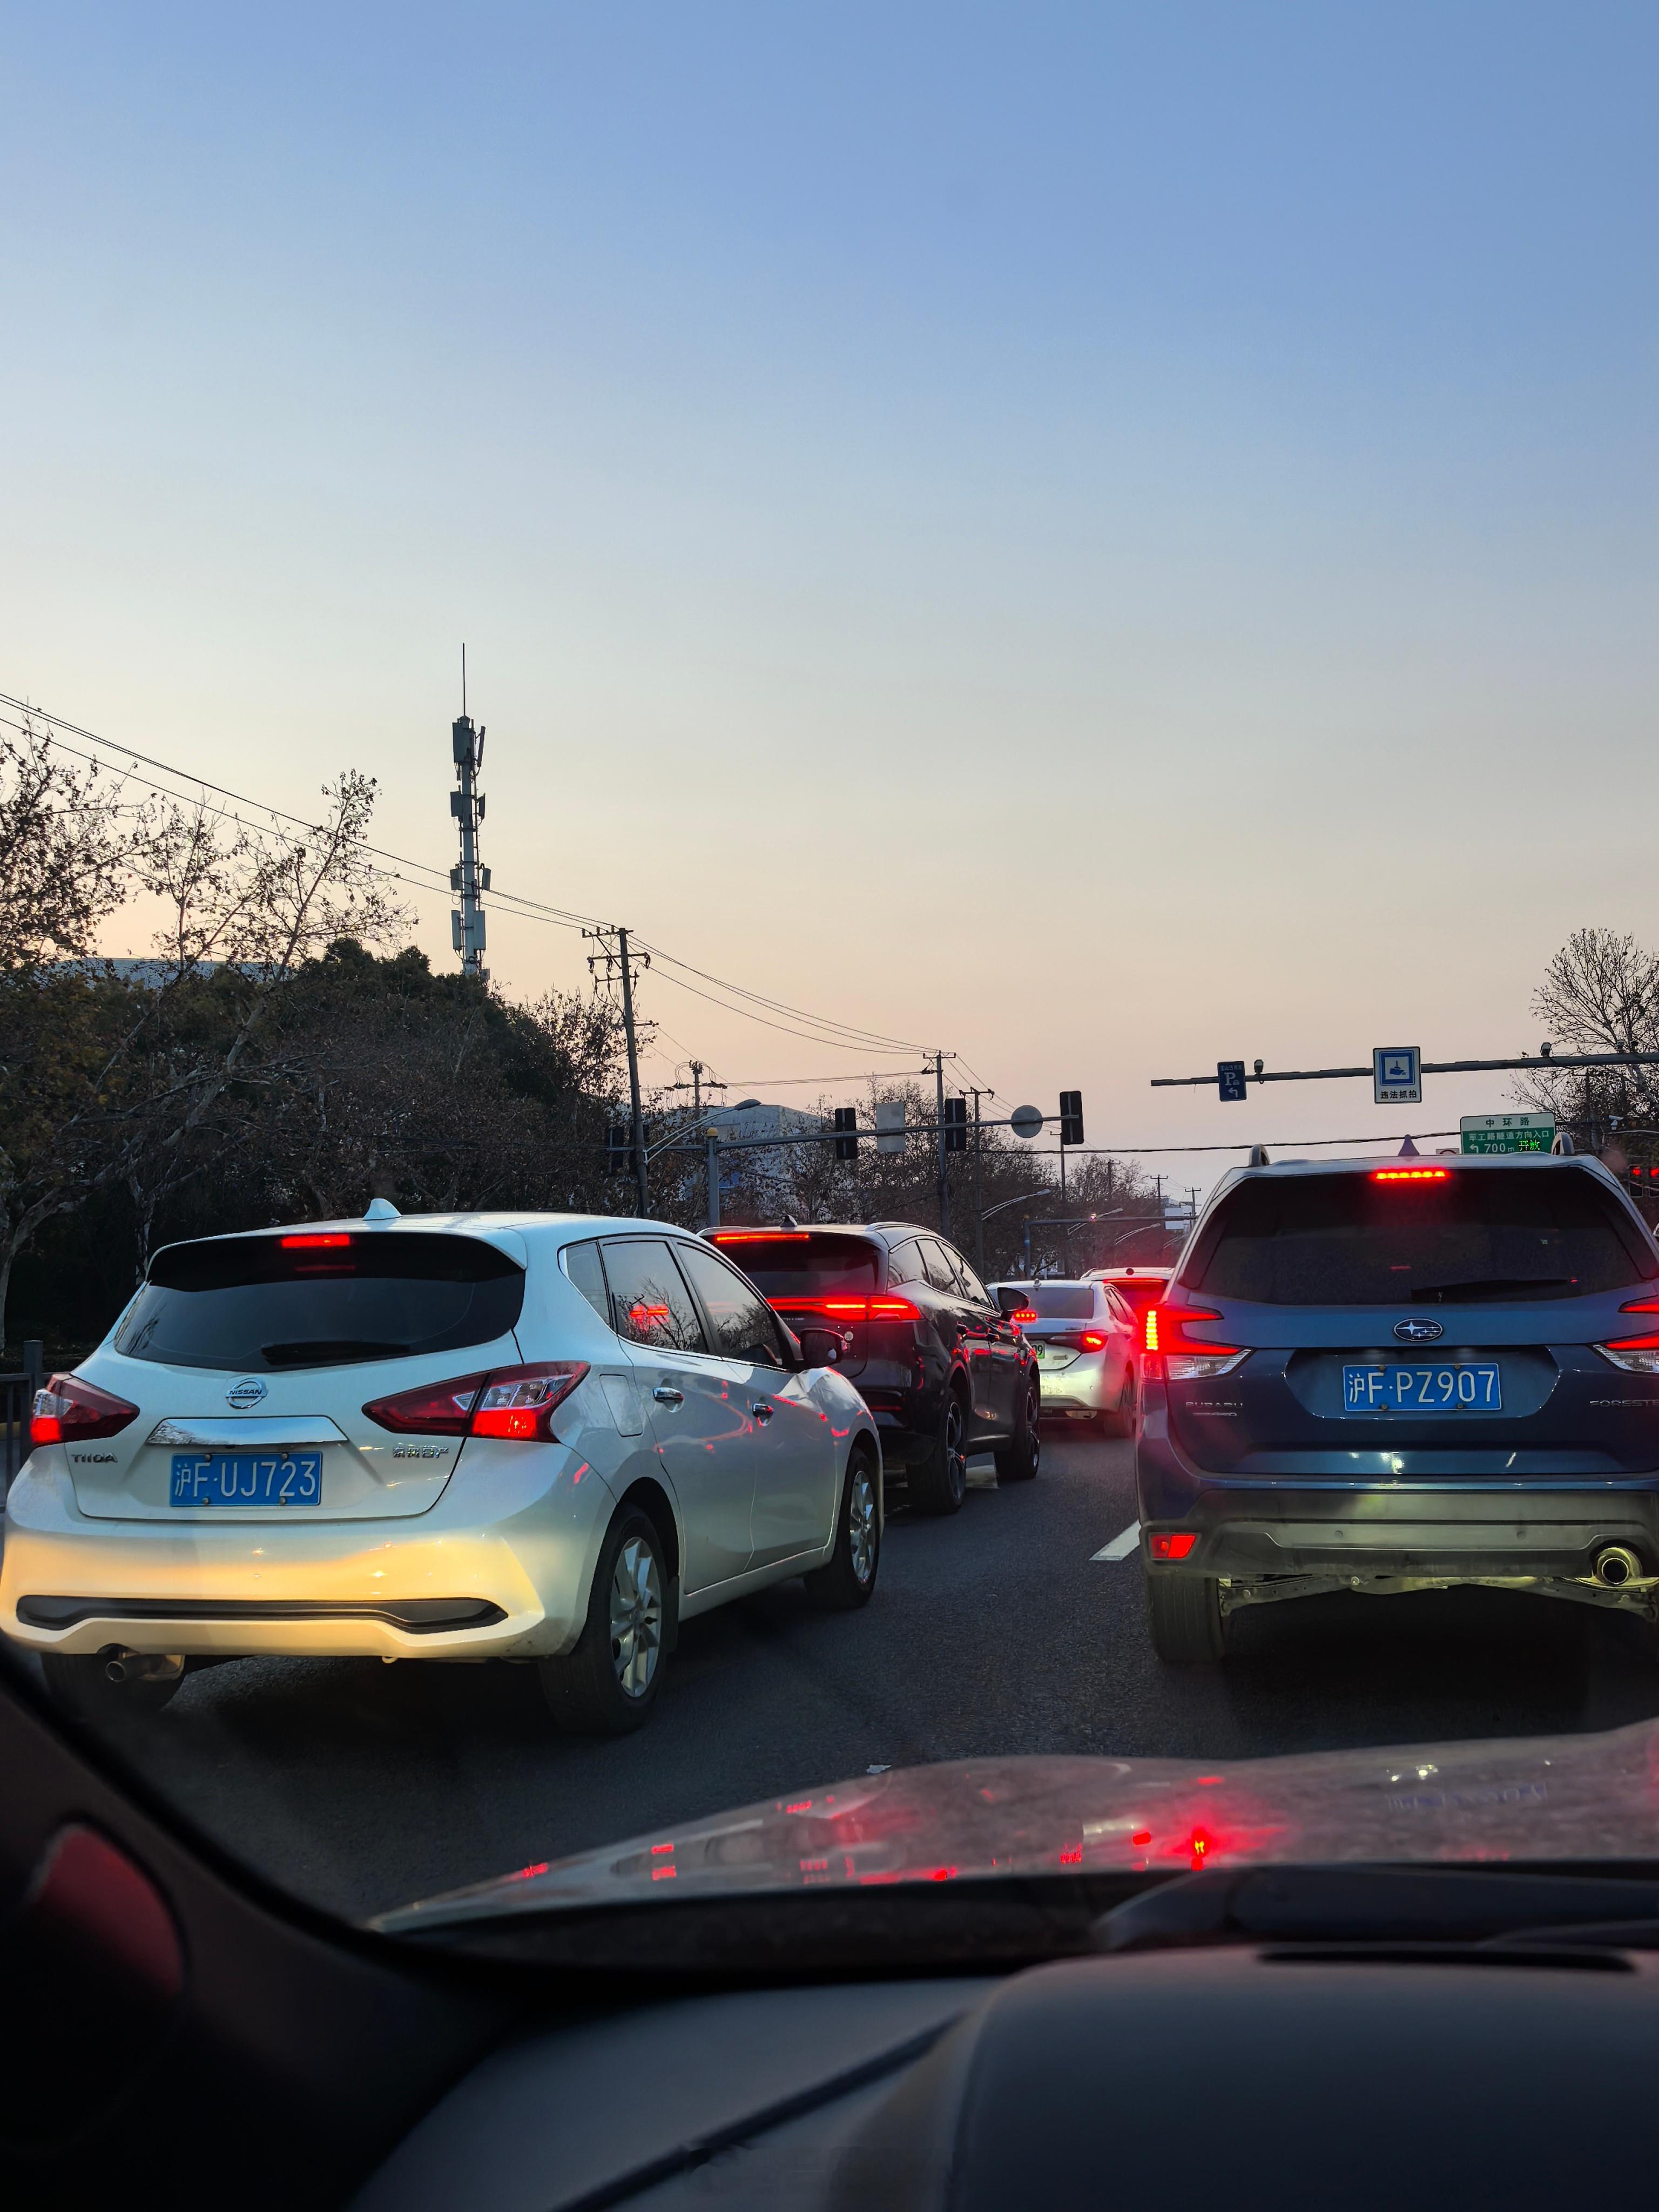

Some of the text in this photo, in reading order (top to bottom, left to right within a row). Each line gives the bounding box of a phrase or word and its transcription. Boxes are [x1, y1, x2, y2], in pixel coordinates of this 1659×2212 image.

[1224, 1072, 1236, 1086] P
[1380, 1090, 1417, 1099] 违法抓拍
[1486, 1117, 1529, 1128] 中环路
[1468, 1130, 1549, 1141] 军工路隧道方向入口
[71, 1453, 118, 1463] TIIDA
